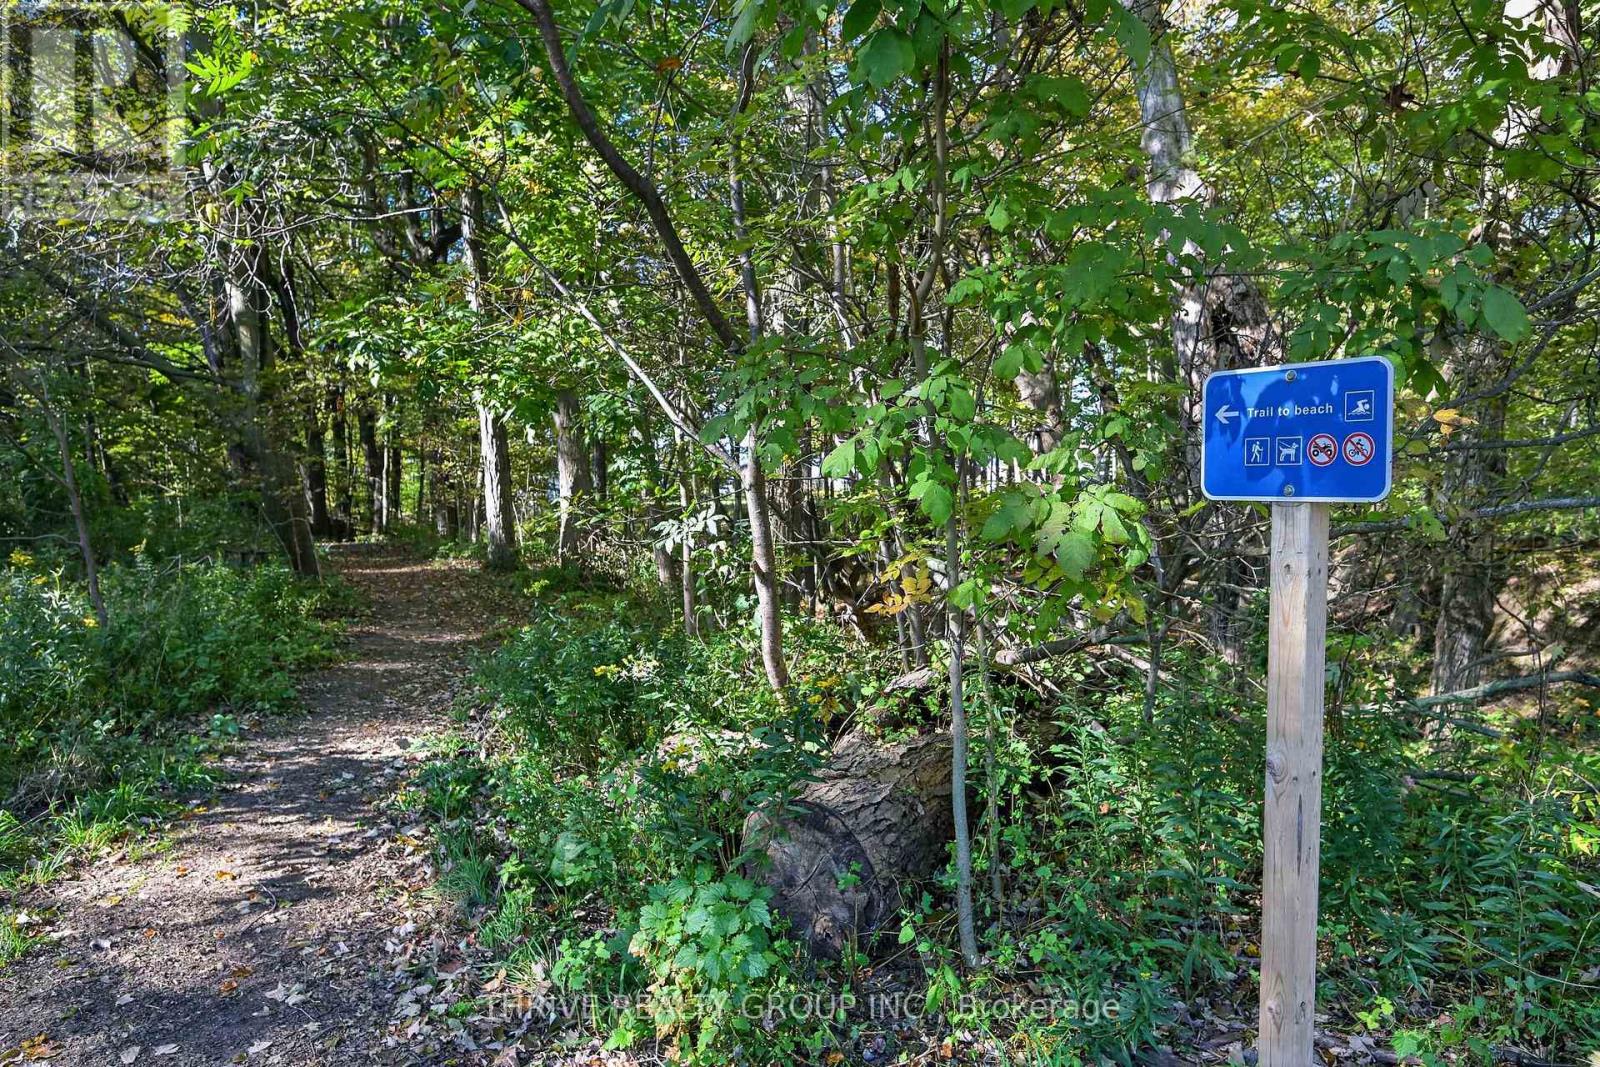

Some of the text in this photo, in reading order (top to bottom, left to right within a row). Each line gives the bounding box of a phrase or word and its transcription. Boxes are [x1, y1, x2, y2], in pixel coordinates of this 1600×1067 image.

[1247, 403, 1333, 418] Trail to beach
